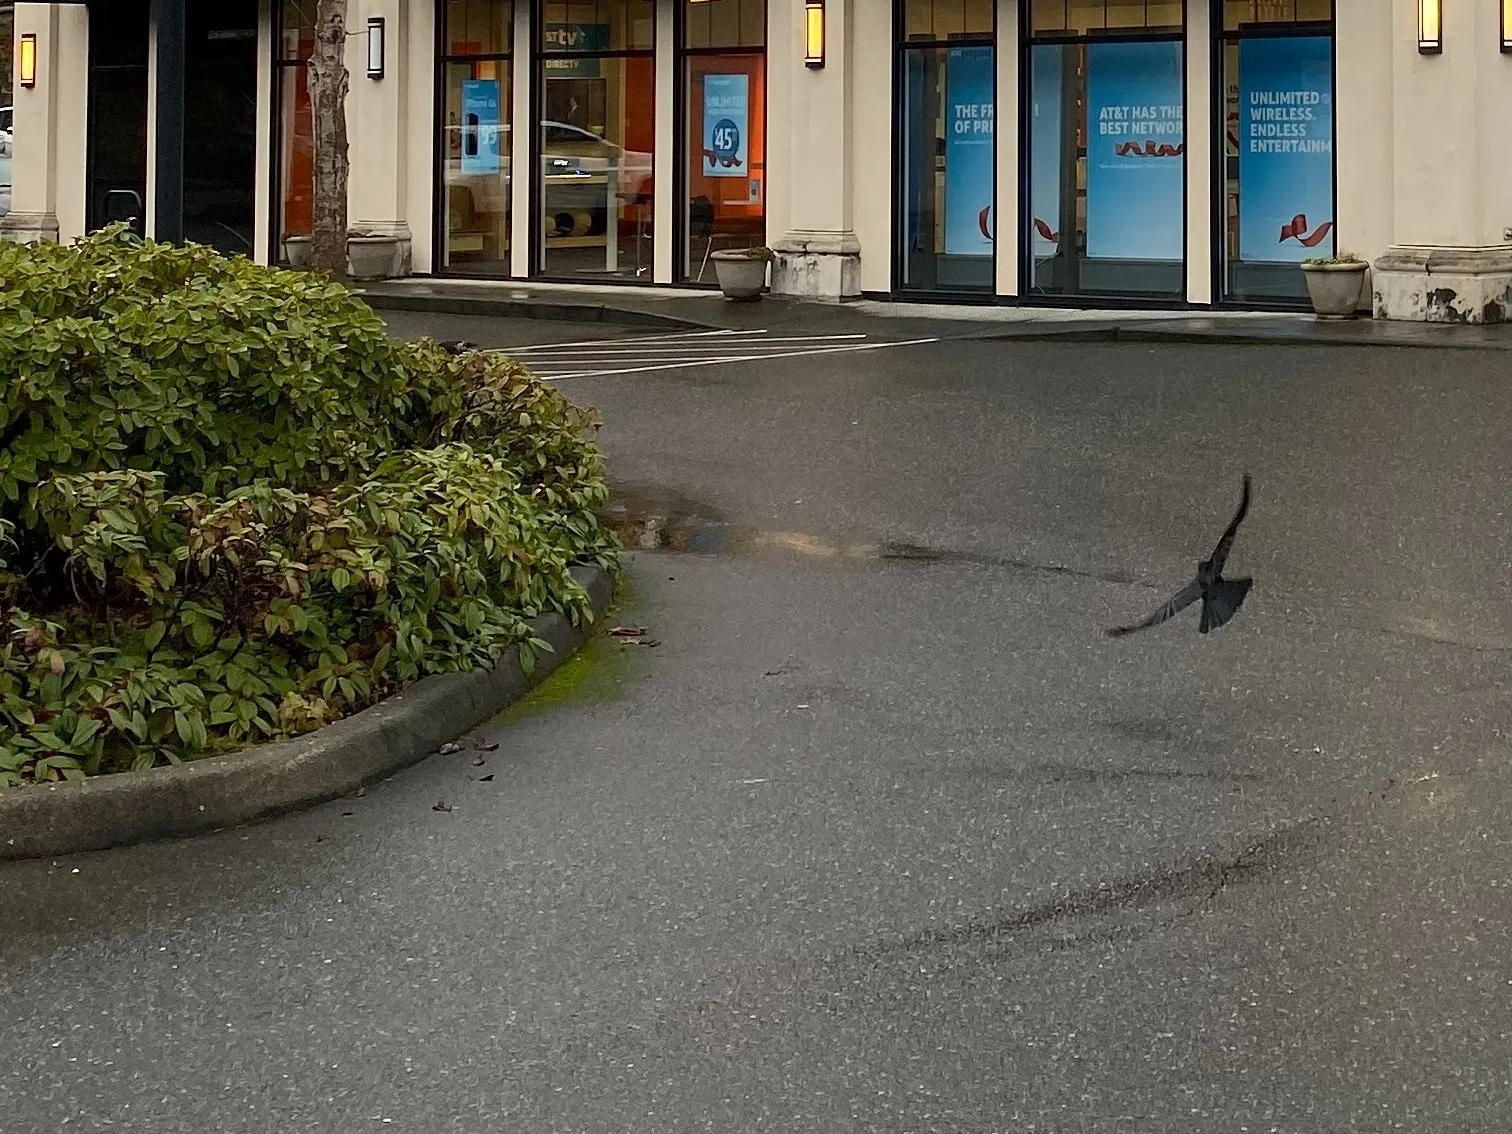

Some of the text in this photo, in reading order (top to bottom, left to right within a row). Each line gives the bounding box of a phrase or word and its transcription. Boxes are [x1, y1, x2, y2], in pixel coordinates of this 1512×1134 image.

[1250, 91, 1320, 106] UNLIMITED
[954, 104, 978, 118] THE
[1099, 106, 1130, 120] AT&T
[1132, 106, 1156, 119] HAS
[1250, 107, 1316, 122] WIRELESS.
[954, 120, 971, 134] OF
[1099, 121, 1130, 135] BEST
[1250, 123, 1307, 137] ENDLESS
